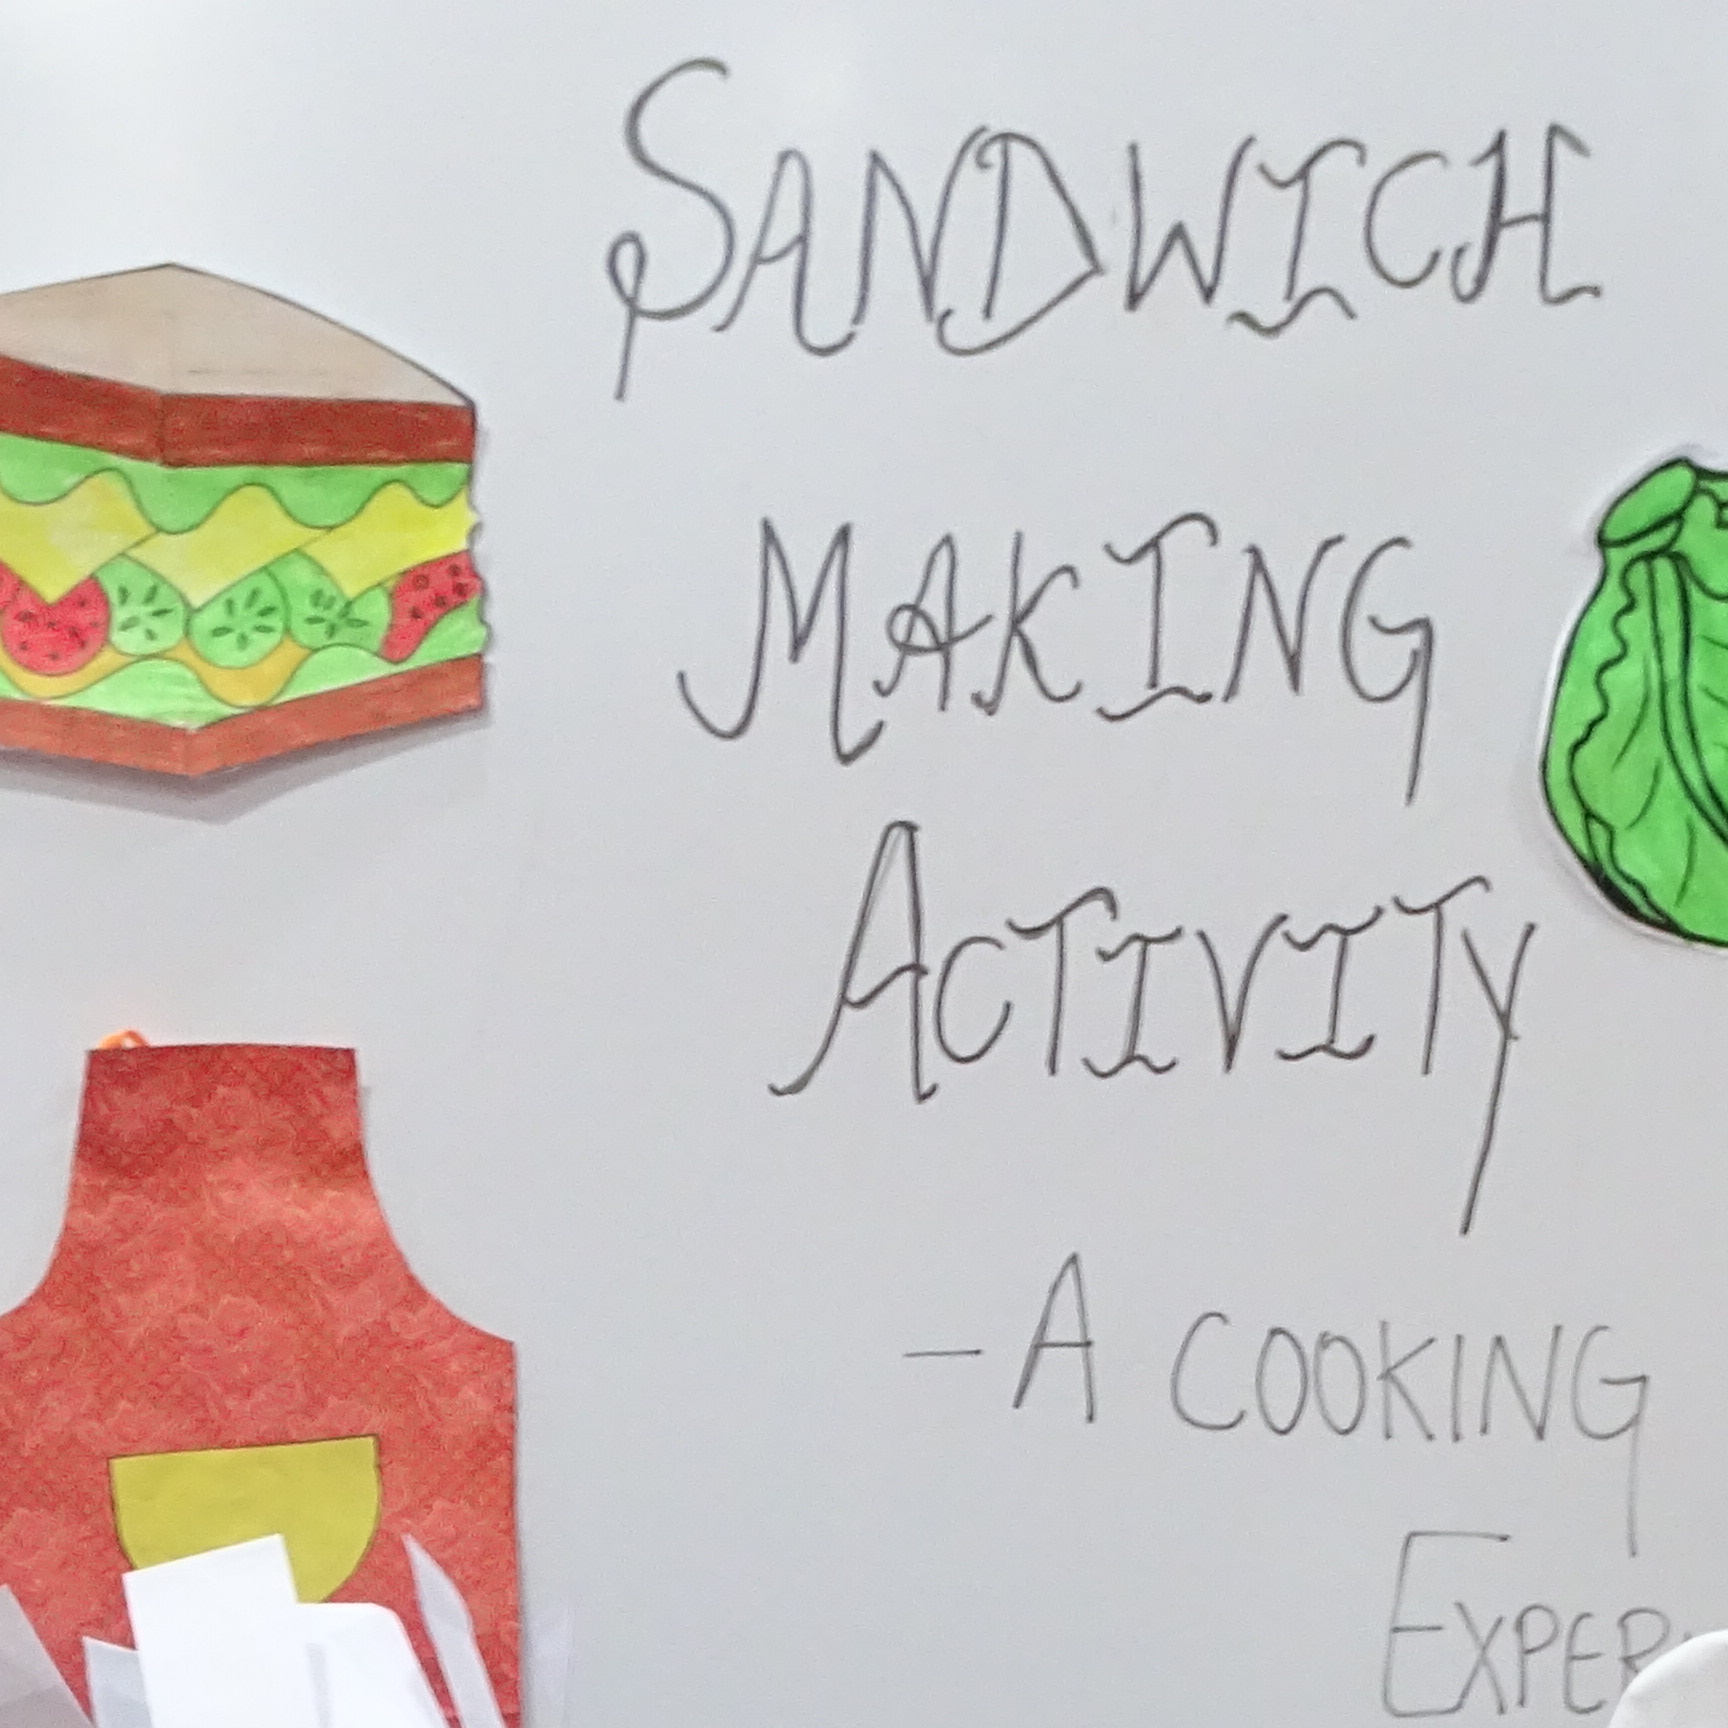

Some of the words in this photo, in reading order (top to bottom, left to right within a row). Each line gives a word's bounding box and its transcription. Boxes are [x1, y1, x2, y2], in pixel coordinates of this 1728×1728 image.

[605, 57, 1602, 402] SANDWICH
[676, 513, 1435, 806] MAKING
[1172, 1311, 1650, 1557] COOKING
